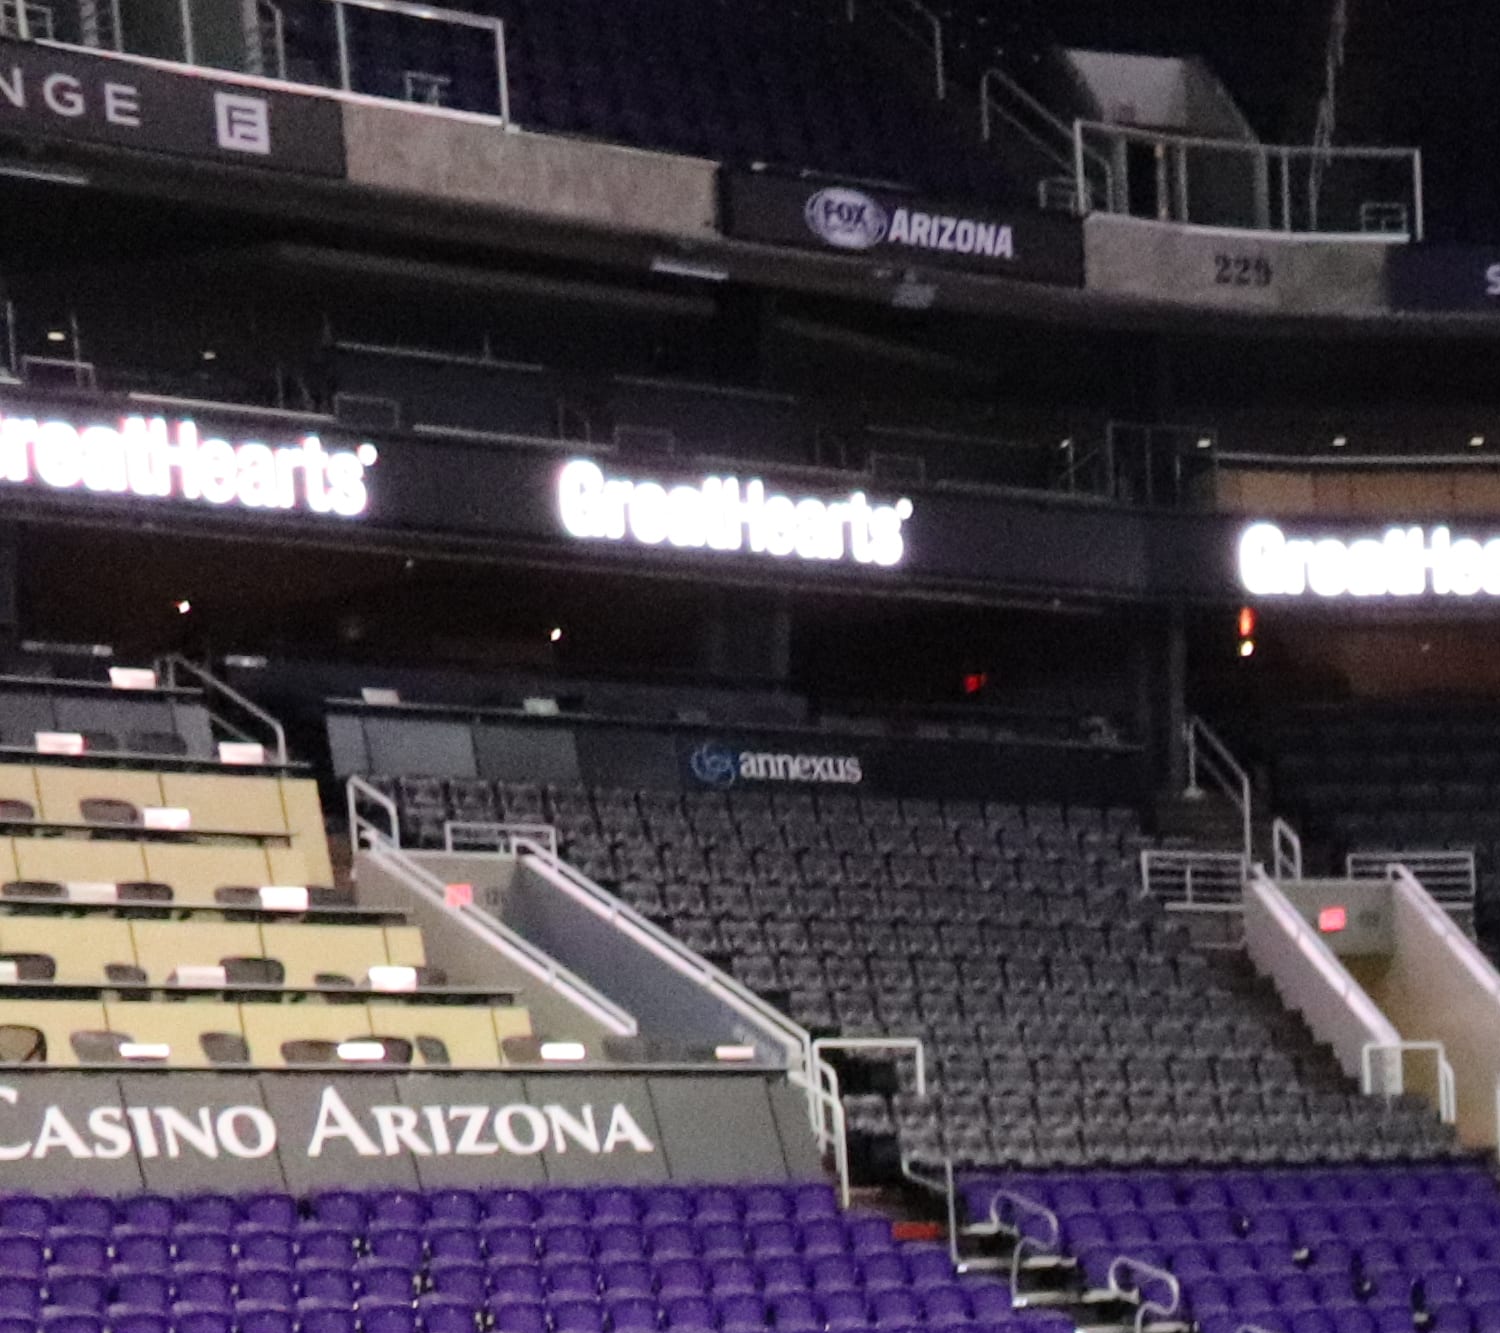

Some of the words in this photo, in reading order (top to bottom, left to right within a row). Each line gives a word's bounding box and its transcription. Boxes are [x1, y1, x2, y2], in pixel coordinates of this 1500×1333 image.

[888, 208, 1013, 259] ARIZONA
[0, 414, 377, 516] reatHearts
[739, 751, 862, 785] annexus
[308, 1086, 655, 1158] ARIZONA
